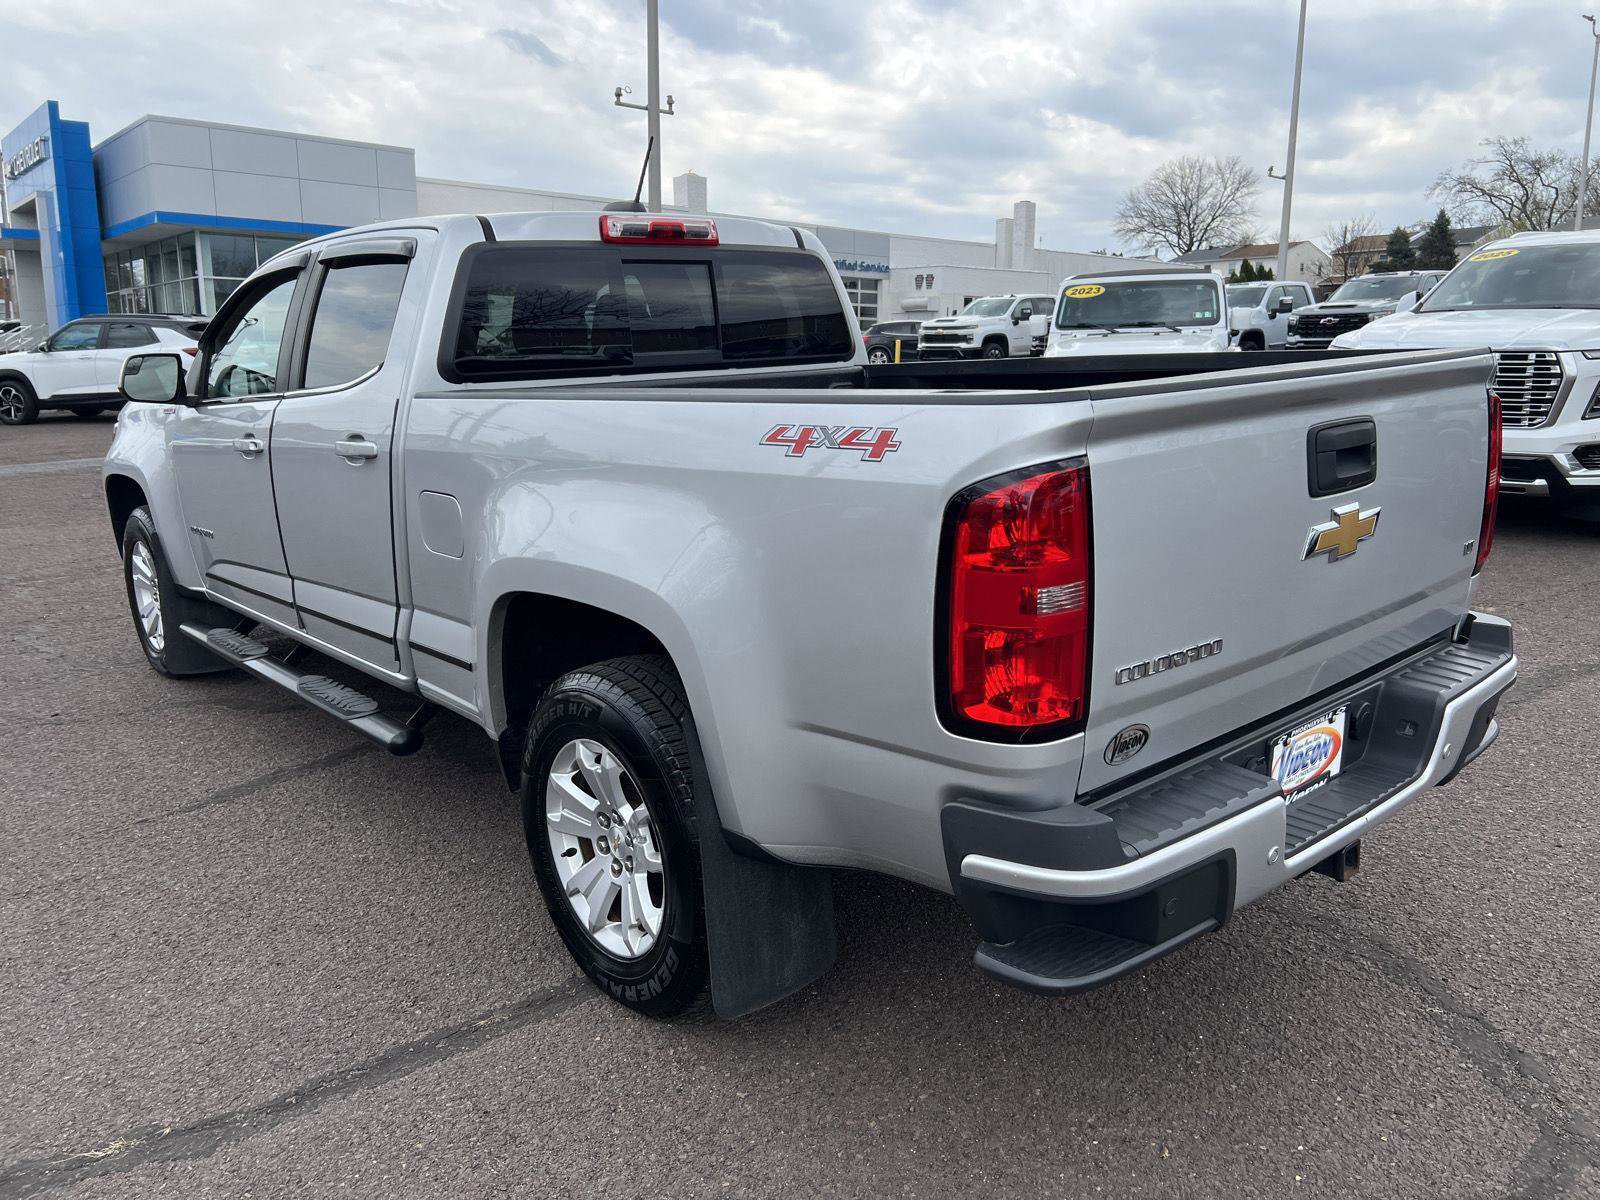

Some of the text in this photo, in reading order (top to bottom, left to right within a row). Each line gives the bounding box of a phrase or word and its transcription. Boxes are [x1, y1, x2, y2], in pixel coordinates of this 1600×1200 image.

[834, 258, 890, 273] tified Service
[1070, 286, 1102, 297] 2023
[1115, 638, 1223, 685] COLORADO
[567, 702, 594, 719] H/T
[1278, 737, 1333, 786] VIDEON
[597, 946, 680, 1001] GENERAL
